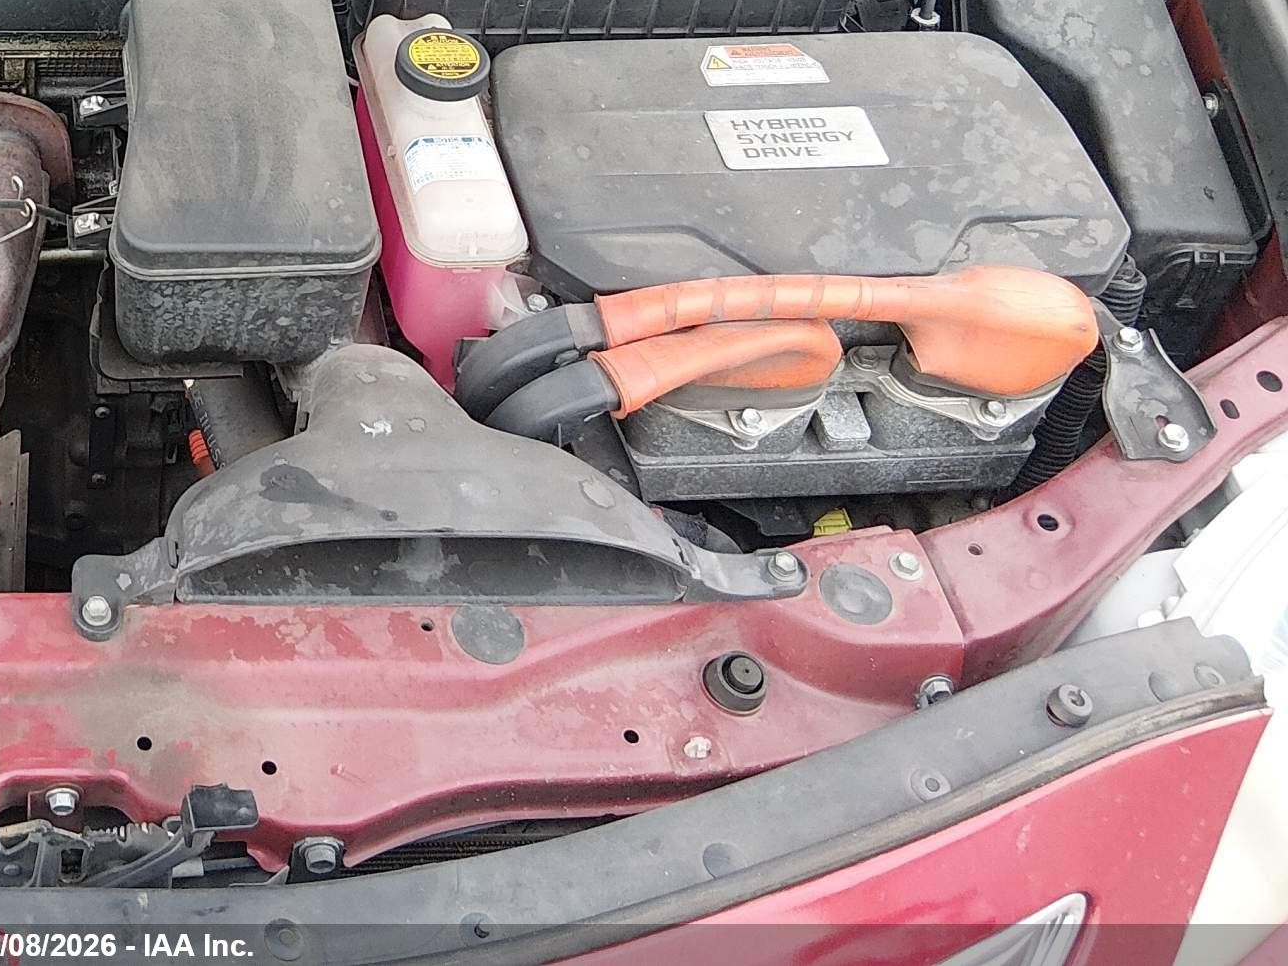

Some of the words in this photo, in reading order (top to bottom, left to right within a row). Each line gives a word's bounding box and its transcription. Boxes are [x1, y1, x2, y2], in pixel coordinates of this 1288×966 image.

[730, 117, 827, 131] HYBRID
[736, 131, 854, 145] SYNERGY
[743, 146, 824, 158] DRIVE
